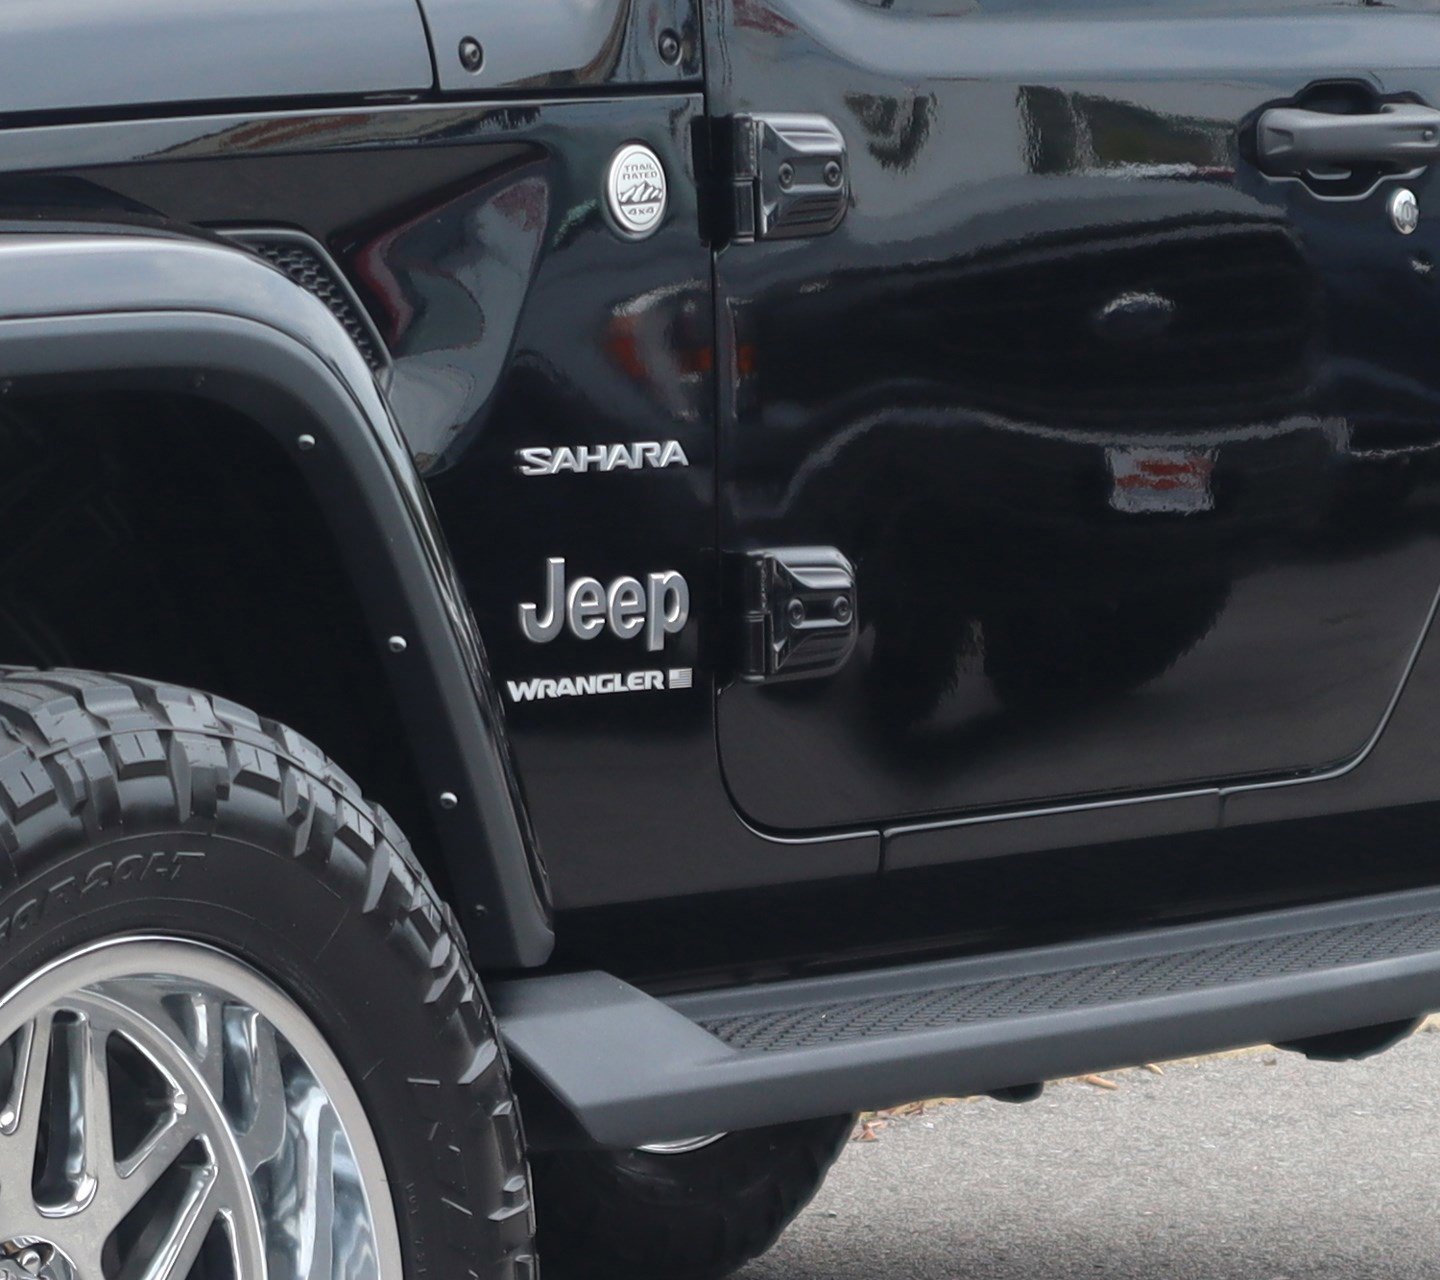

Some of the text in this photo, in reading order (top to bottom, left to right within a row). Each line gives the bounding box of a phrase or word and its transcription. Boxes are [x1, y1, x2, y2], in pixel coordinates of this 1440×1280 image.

[622, 170, 658, 180] RATED
[623, 163, 655, 172] TRAIL
[518, 439, 689, 476] SAHARA
[519, 556, 690, 652] Jeep
[507, 671, 665, 703] WRANGLER
